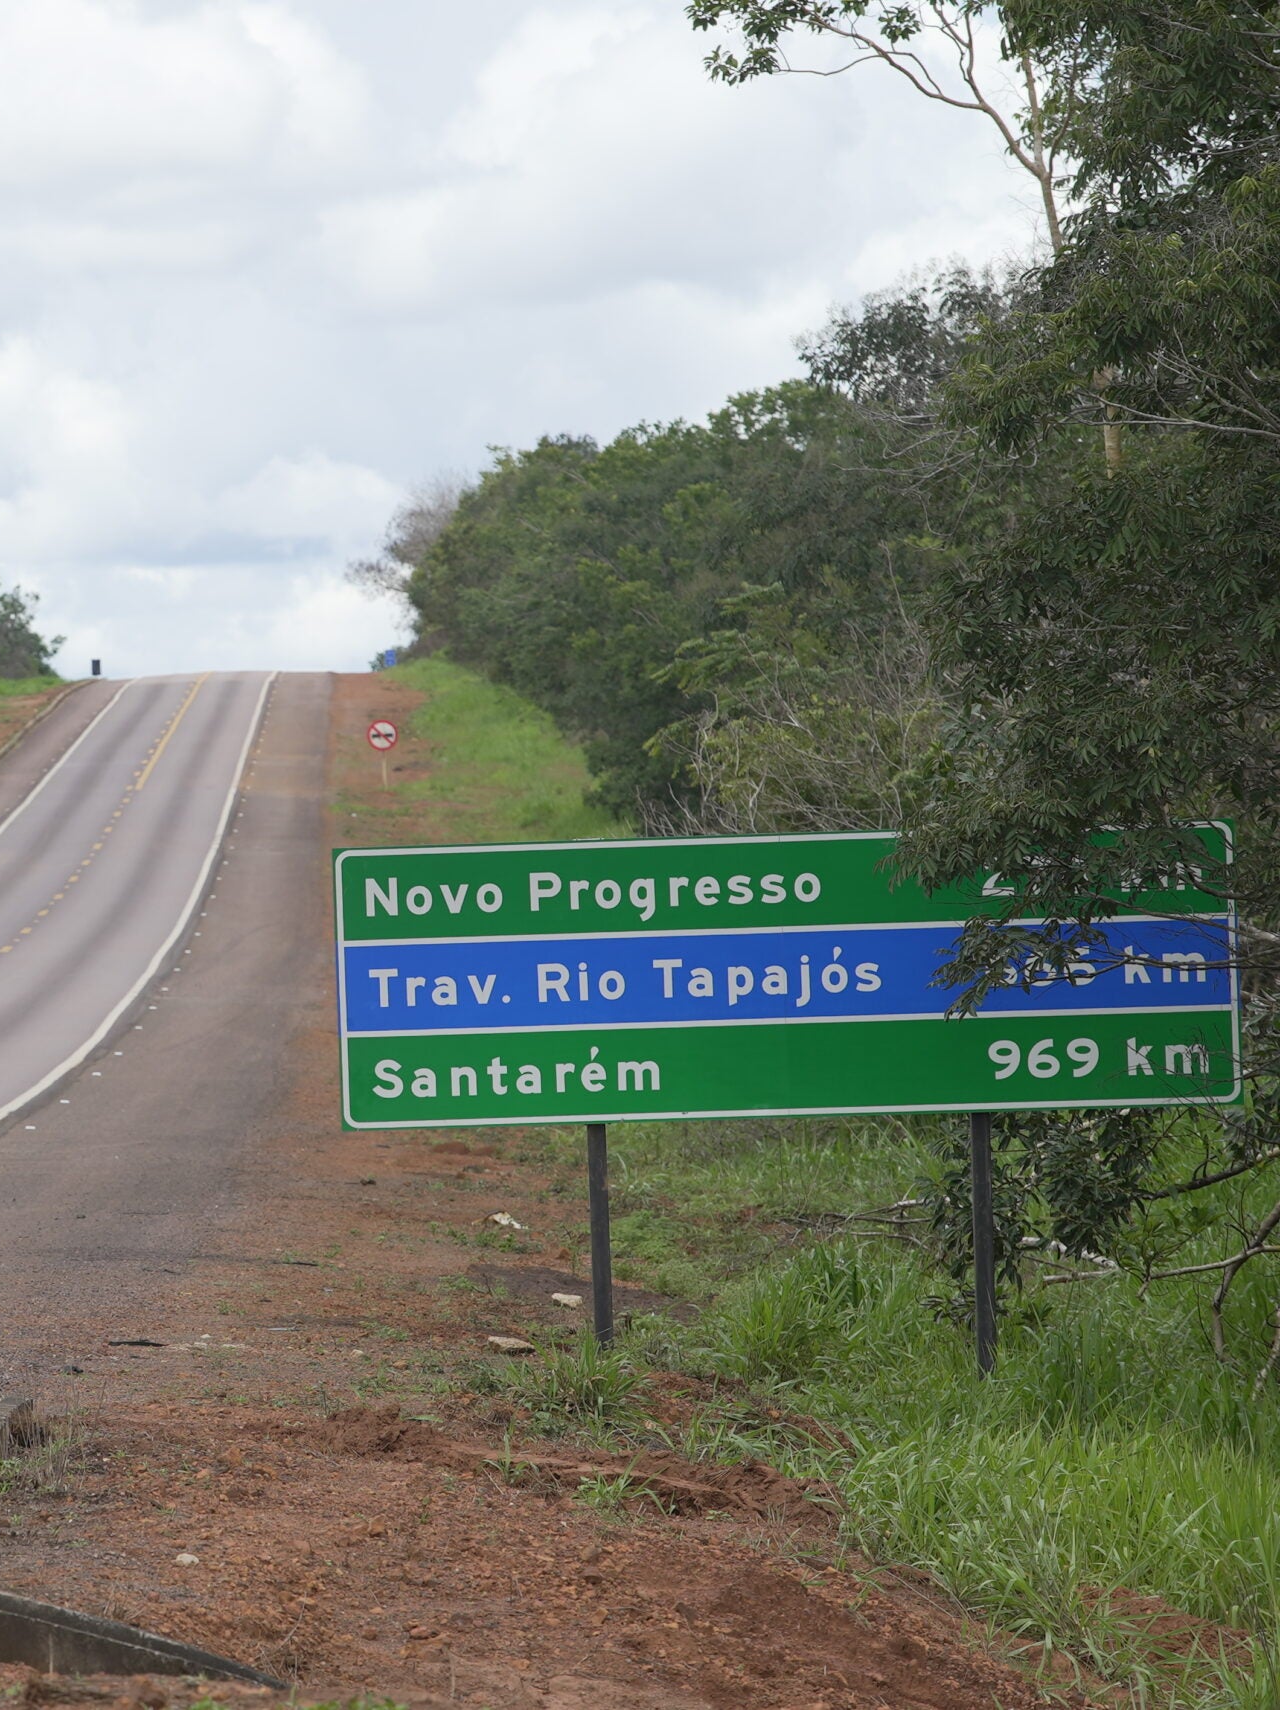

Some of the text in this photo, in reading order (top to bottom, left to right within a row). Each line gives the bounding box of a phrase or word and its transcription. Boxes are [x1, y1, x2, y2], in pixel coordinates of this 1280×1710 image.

[365, 877, 503, 917] Novo
[529, 871, 821, 922] Progresso
[369, 968, 510, 1008] Trav.
[537, 962, 625, 1003] Rio
[652, 946, 882, 1007] Tapajós
[1124, 945, 1206, 984] km
[372, 1037, 1210, 1099] Santarém 969 km
